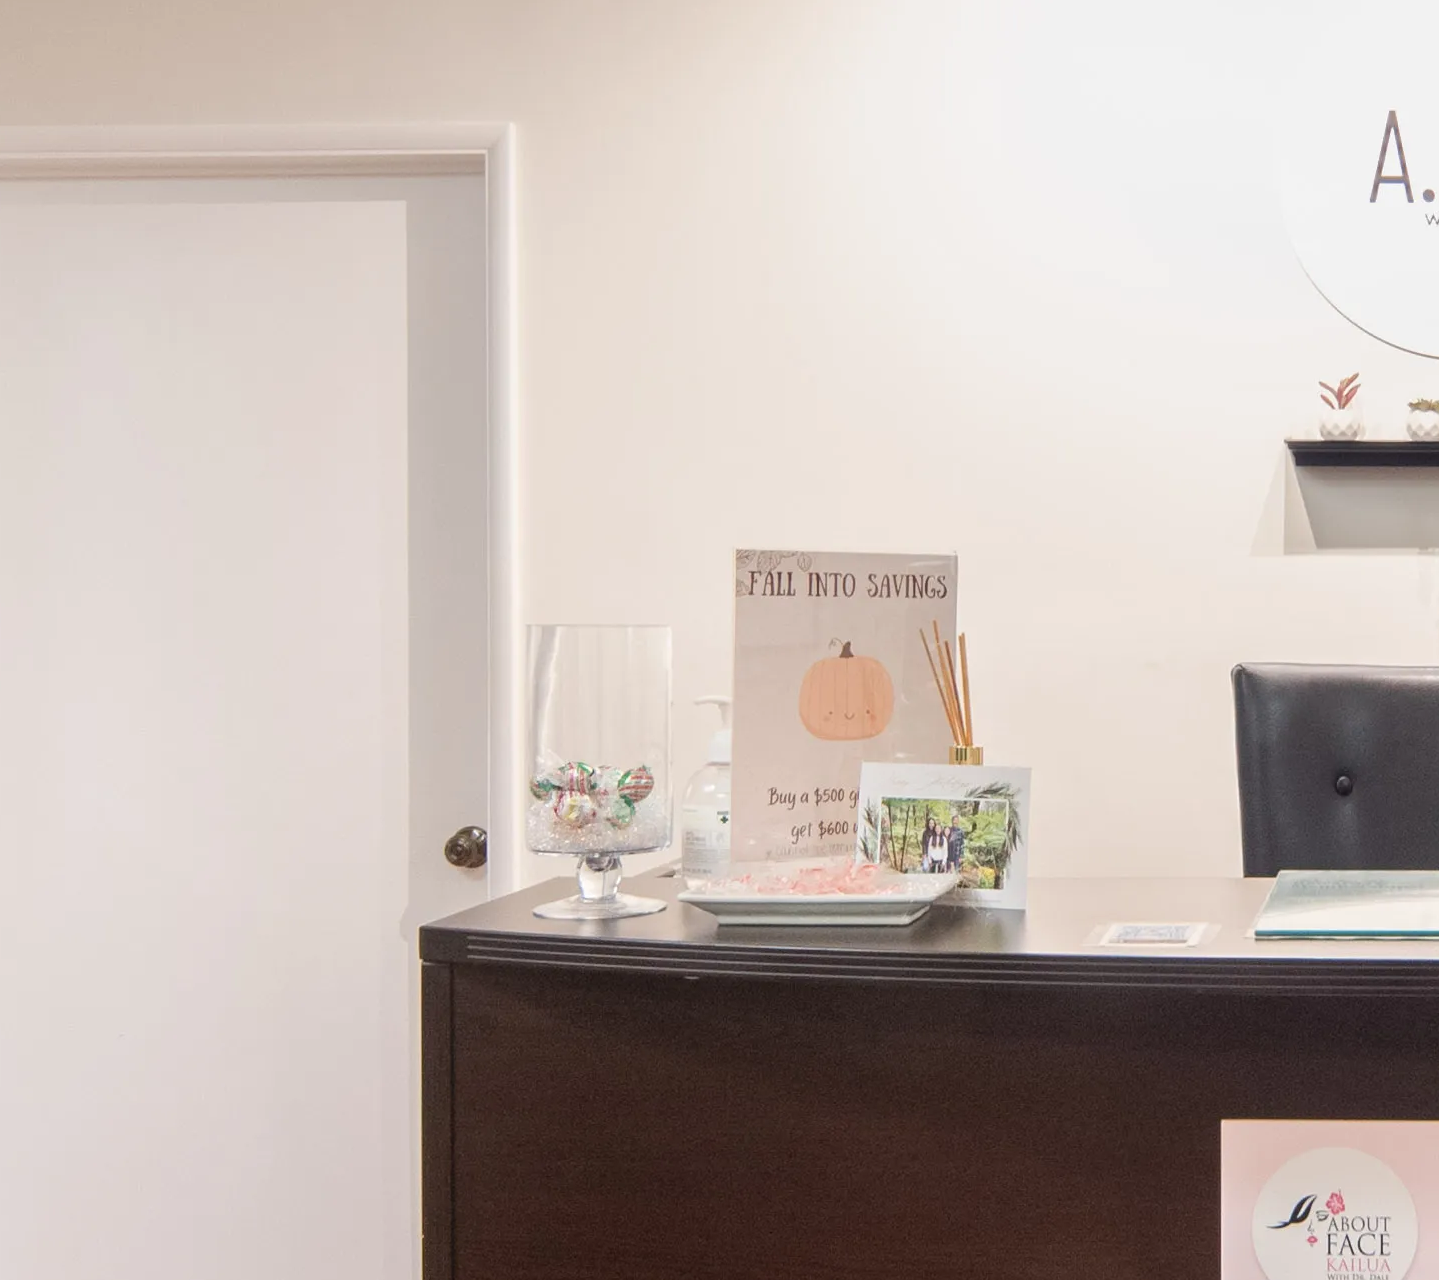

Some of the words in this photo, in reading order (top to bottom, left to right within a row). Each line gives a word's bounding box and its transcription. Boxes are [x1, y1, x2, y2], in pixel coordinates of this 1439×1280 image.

[748, 570, 796, 597] FALL
[807, 571, 856, 598] INTO
[867, 572, 948, 599] SAVINGS
[768, 787, 798, 810] Buy
[800, 791, 809, 804] a
[814, 786, 845, 805] $500
[791, 821, 812, 845] get
[818, 821, 850, 838] $600
[1327, 1216, 1392, 1233] ABOUT
[1326, 1233, 1391, 1257] FACE
[1326, 1258, 1392, 1273] KAILUA
